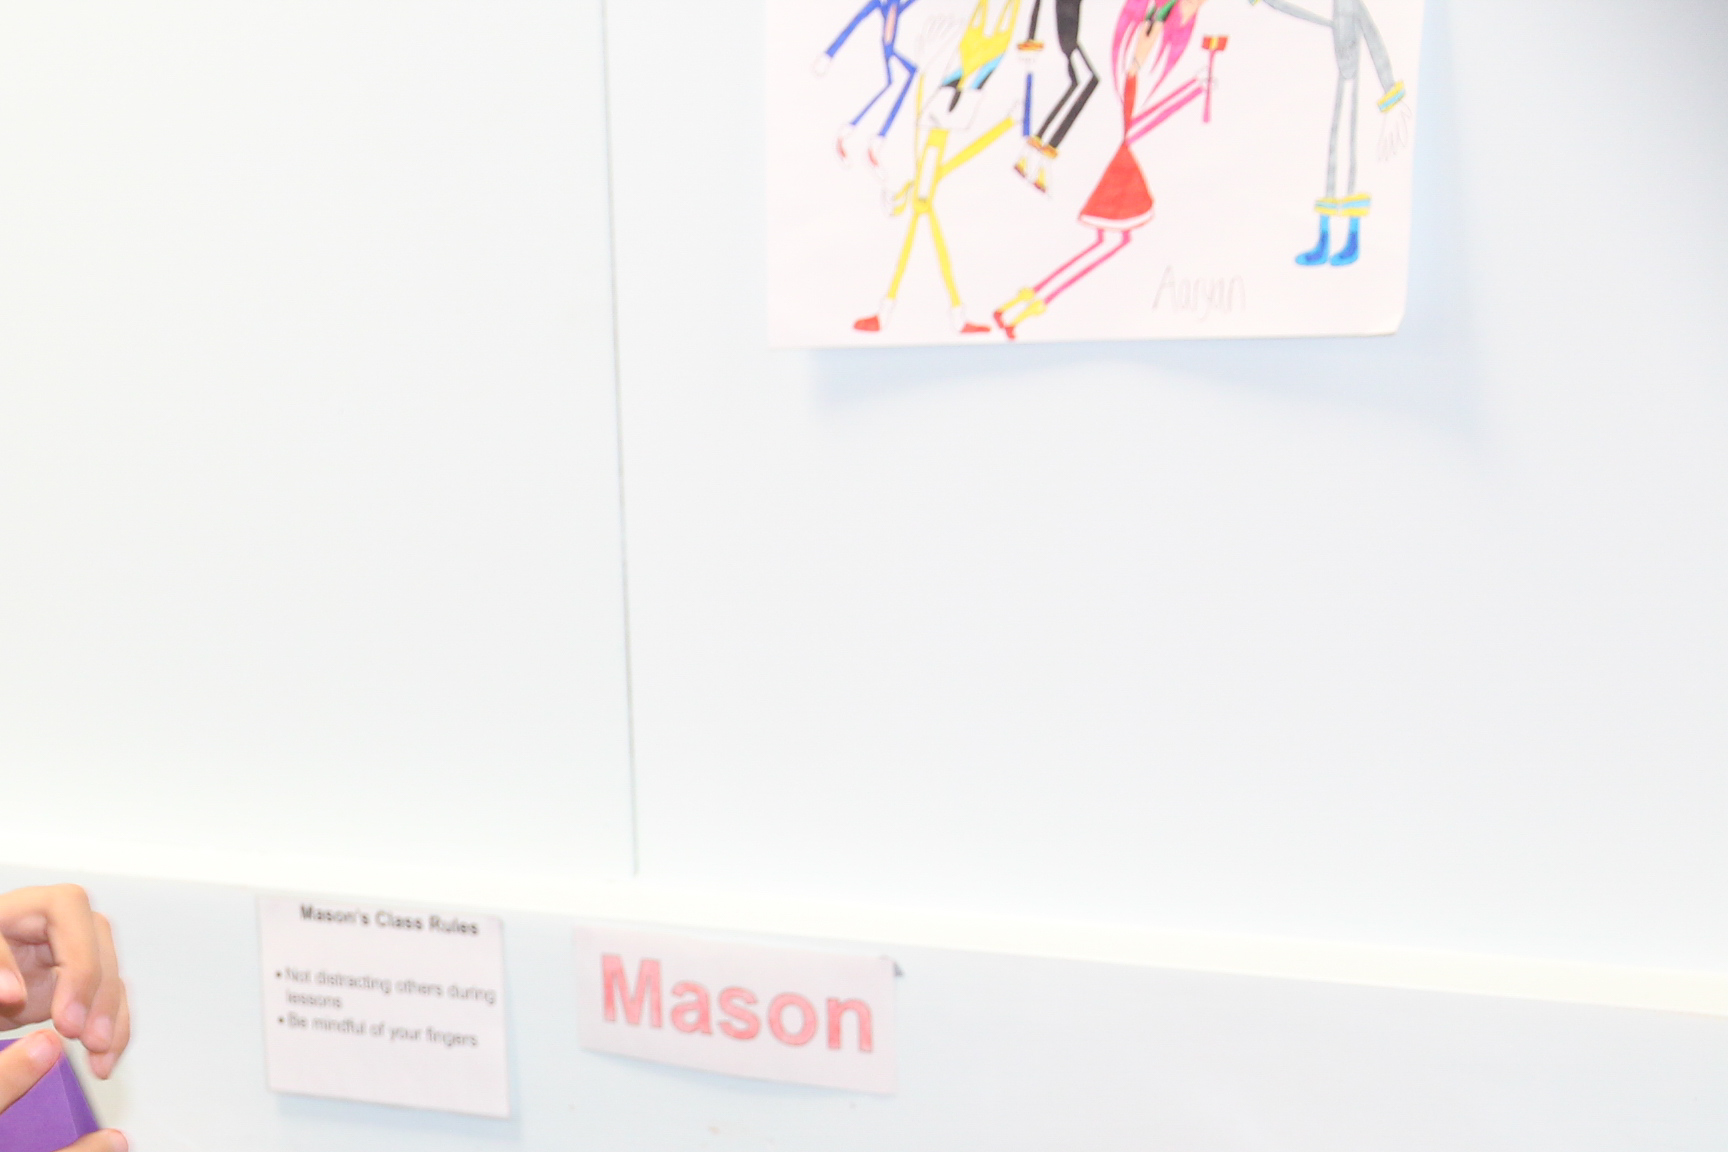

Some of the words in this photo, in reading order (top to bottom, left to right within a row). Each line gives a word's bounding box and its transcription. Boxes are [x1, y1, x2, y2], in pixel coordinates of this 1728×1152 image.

[300, 903, 369, 925] Mason's
[375, 910, 422, 930] Class
[428, 914, 478, 935] Rules
[285, 967, 311, 983] Not
[317, 970, 392, 995] distracting
[395, 979, 442, 997] others
[447, 984, 497, 1005] during
[601, 954, 874, 1053] Mason
[312, 1017, 365, 1035] mindful
[369, 1022, 385, 1036] of
[389, 1027, 421, 1042] your
[426, 1026, 478, 1047] fingers
